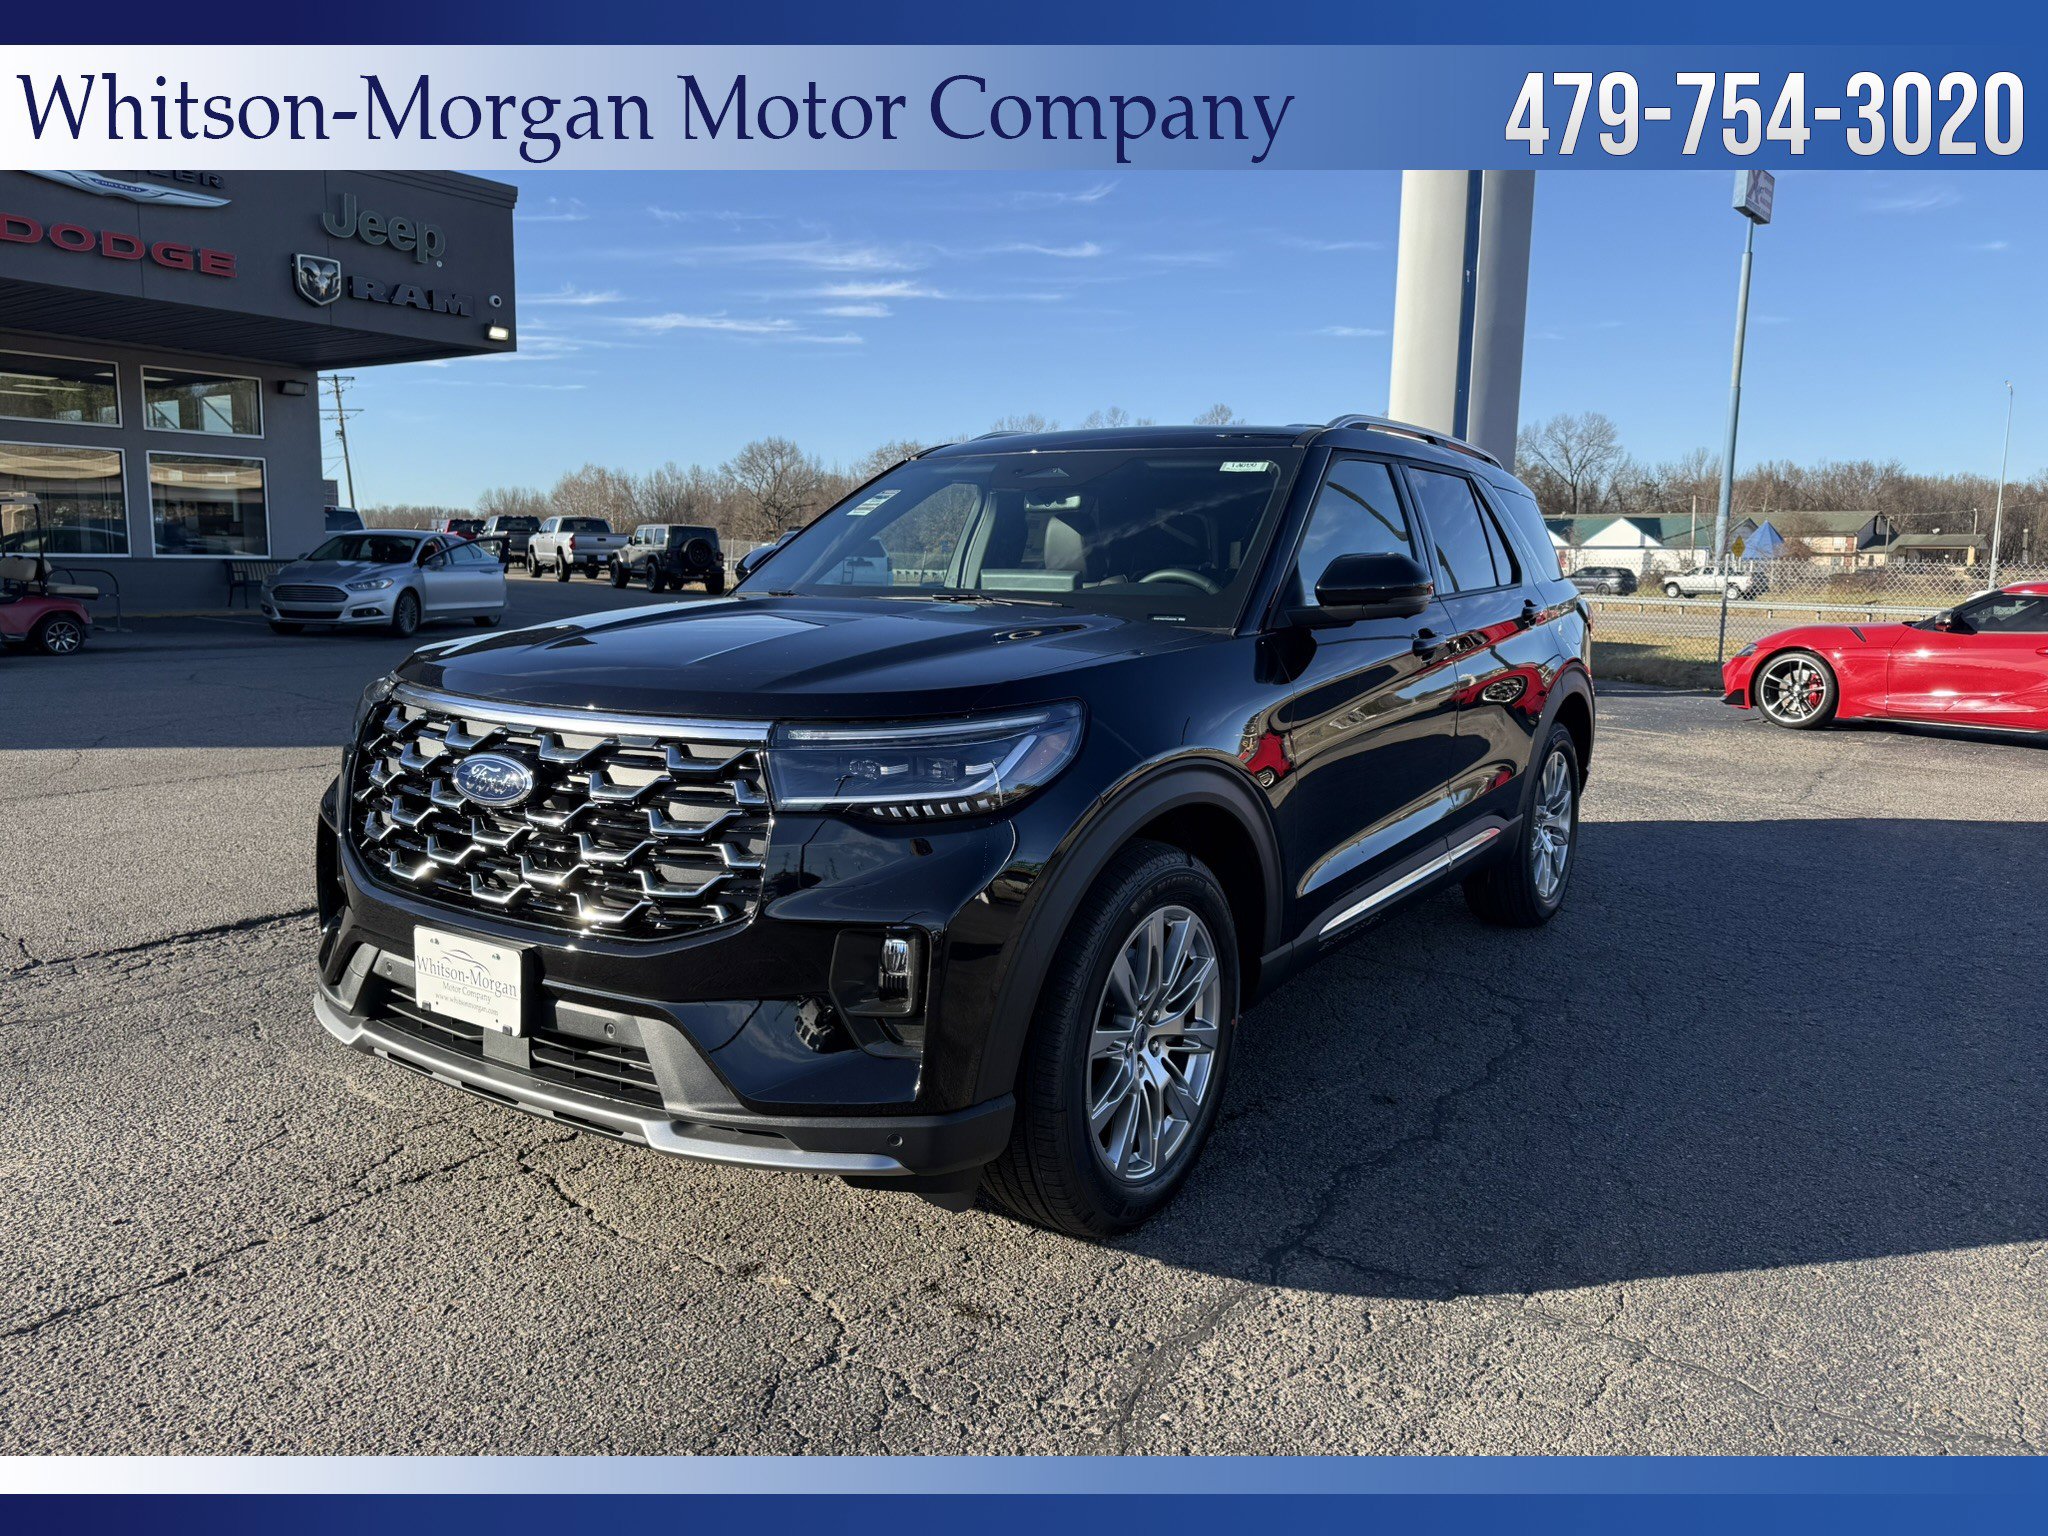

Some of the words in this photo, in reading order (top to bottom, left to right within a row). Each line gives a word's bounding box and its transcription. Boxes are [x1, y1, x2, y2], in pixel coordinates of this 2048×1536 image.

[0, 212, 238, 278] DODGE
[321, 193, 446, 264] Jeep
[348, 275, 475, 318] RAM
[460, 762, 524, 796] Ford
[416, 955, 518, 998] Whitson-Morgan
[442, 980, 461, 994] Motor
[461, 985, 492, 1005] Company
